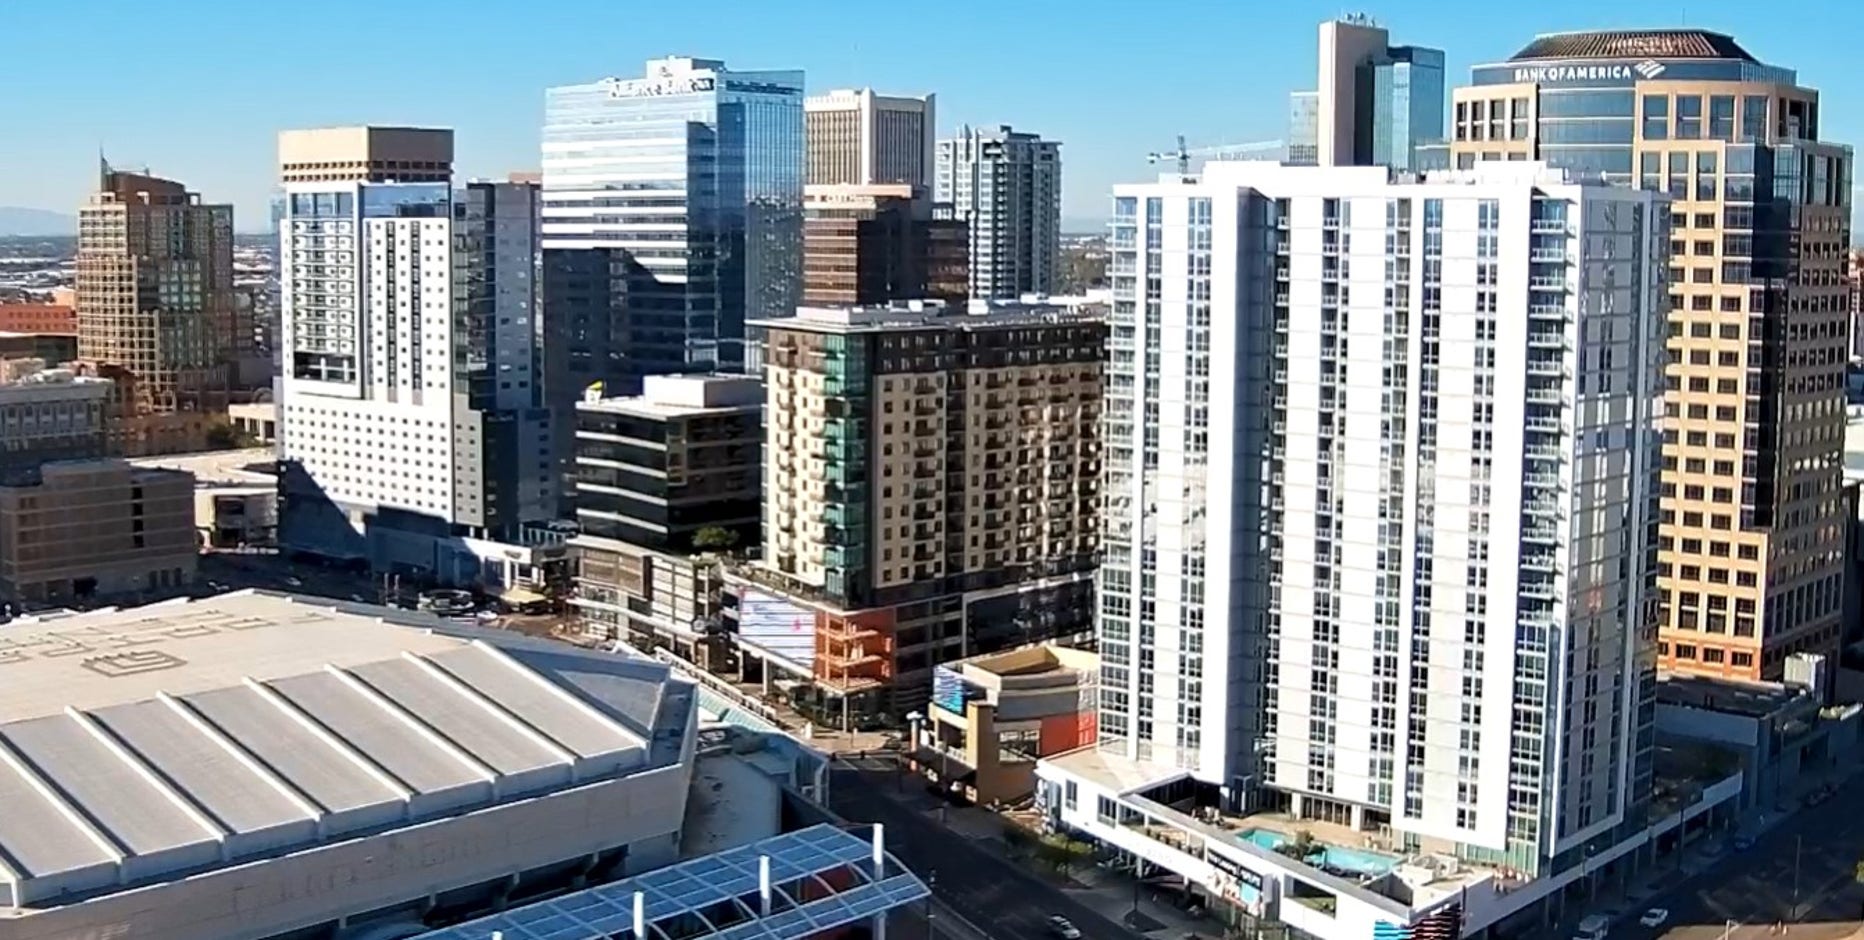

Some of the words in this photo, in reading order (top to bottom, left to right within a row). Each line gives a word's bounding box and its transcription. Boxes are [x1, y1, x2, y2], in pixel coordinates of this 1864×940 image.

[1515, 67, 1547, 82] BANK
[1549, 67, 1566, 81] OF
[1567, 65, 1632, 80] AMERICA
